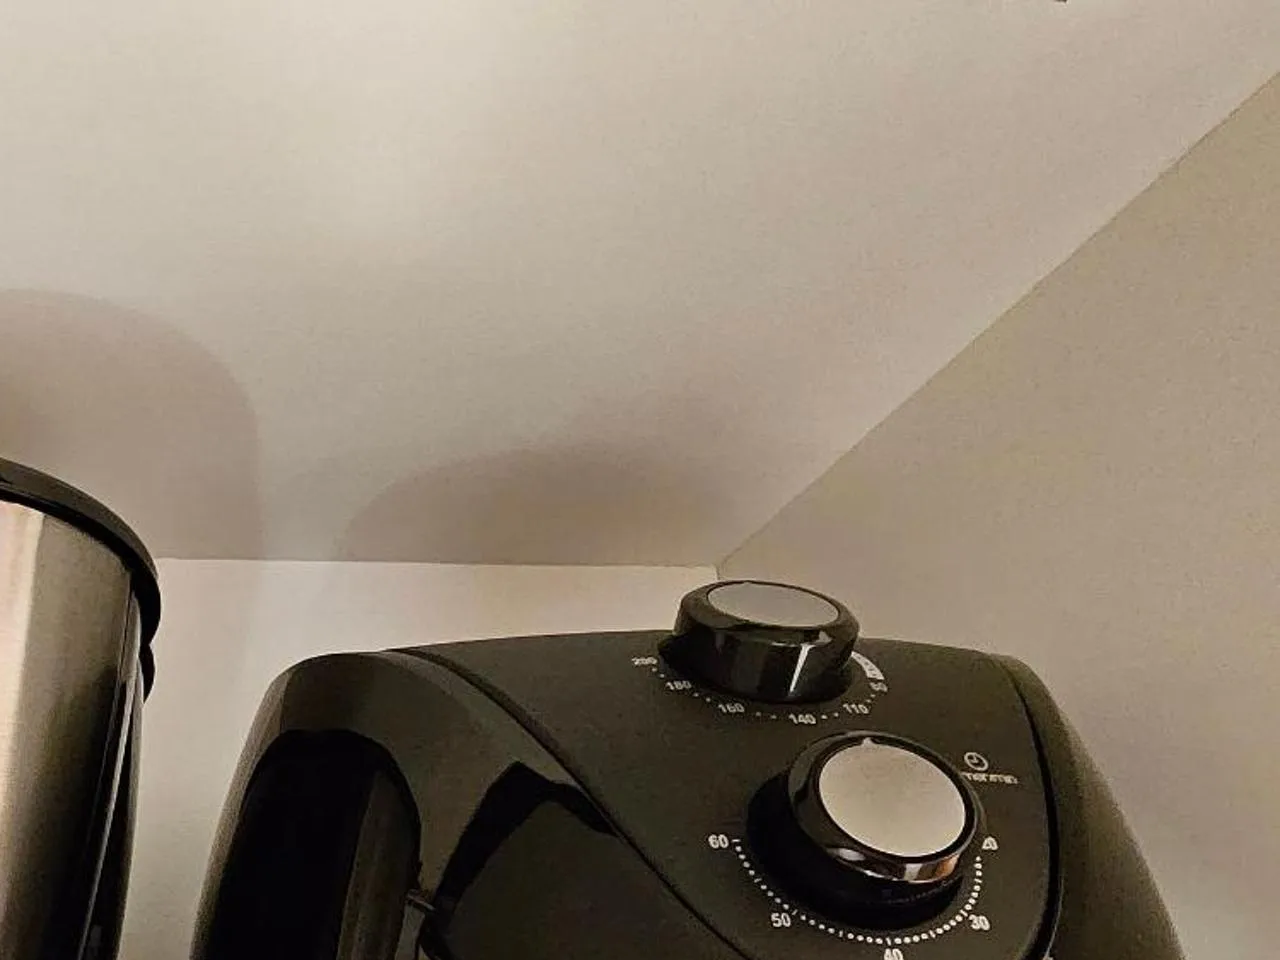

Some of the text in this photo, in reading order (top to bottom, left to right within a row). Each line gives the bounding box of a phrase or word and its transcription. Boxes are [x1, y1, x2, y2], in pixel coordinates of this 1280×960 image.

[718, 703, 745, 713] 160
[788, 714, 817, 725] 140
[708, 834, 730, 850] 60
[770, 912, 792, 928] 50
[969, 914, 991, 931] 30
